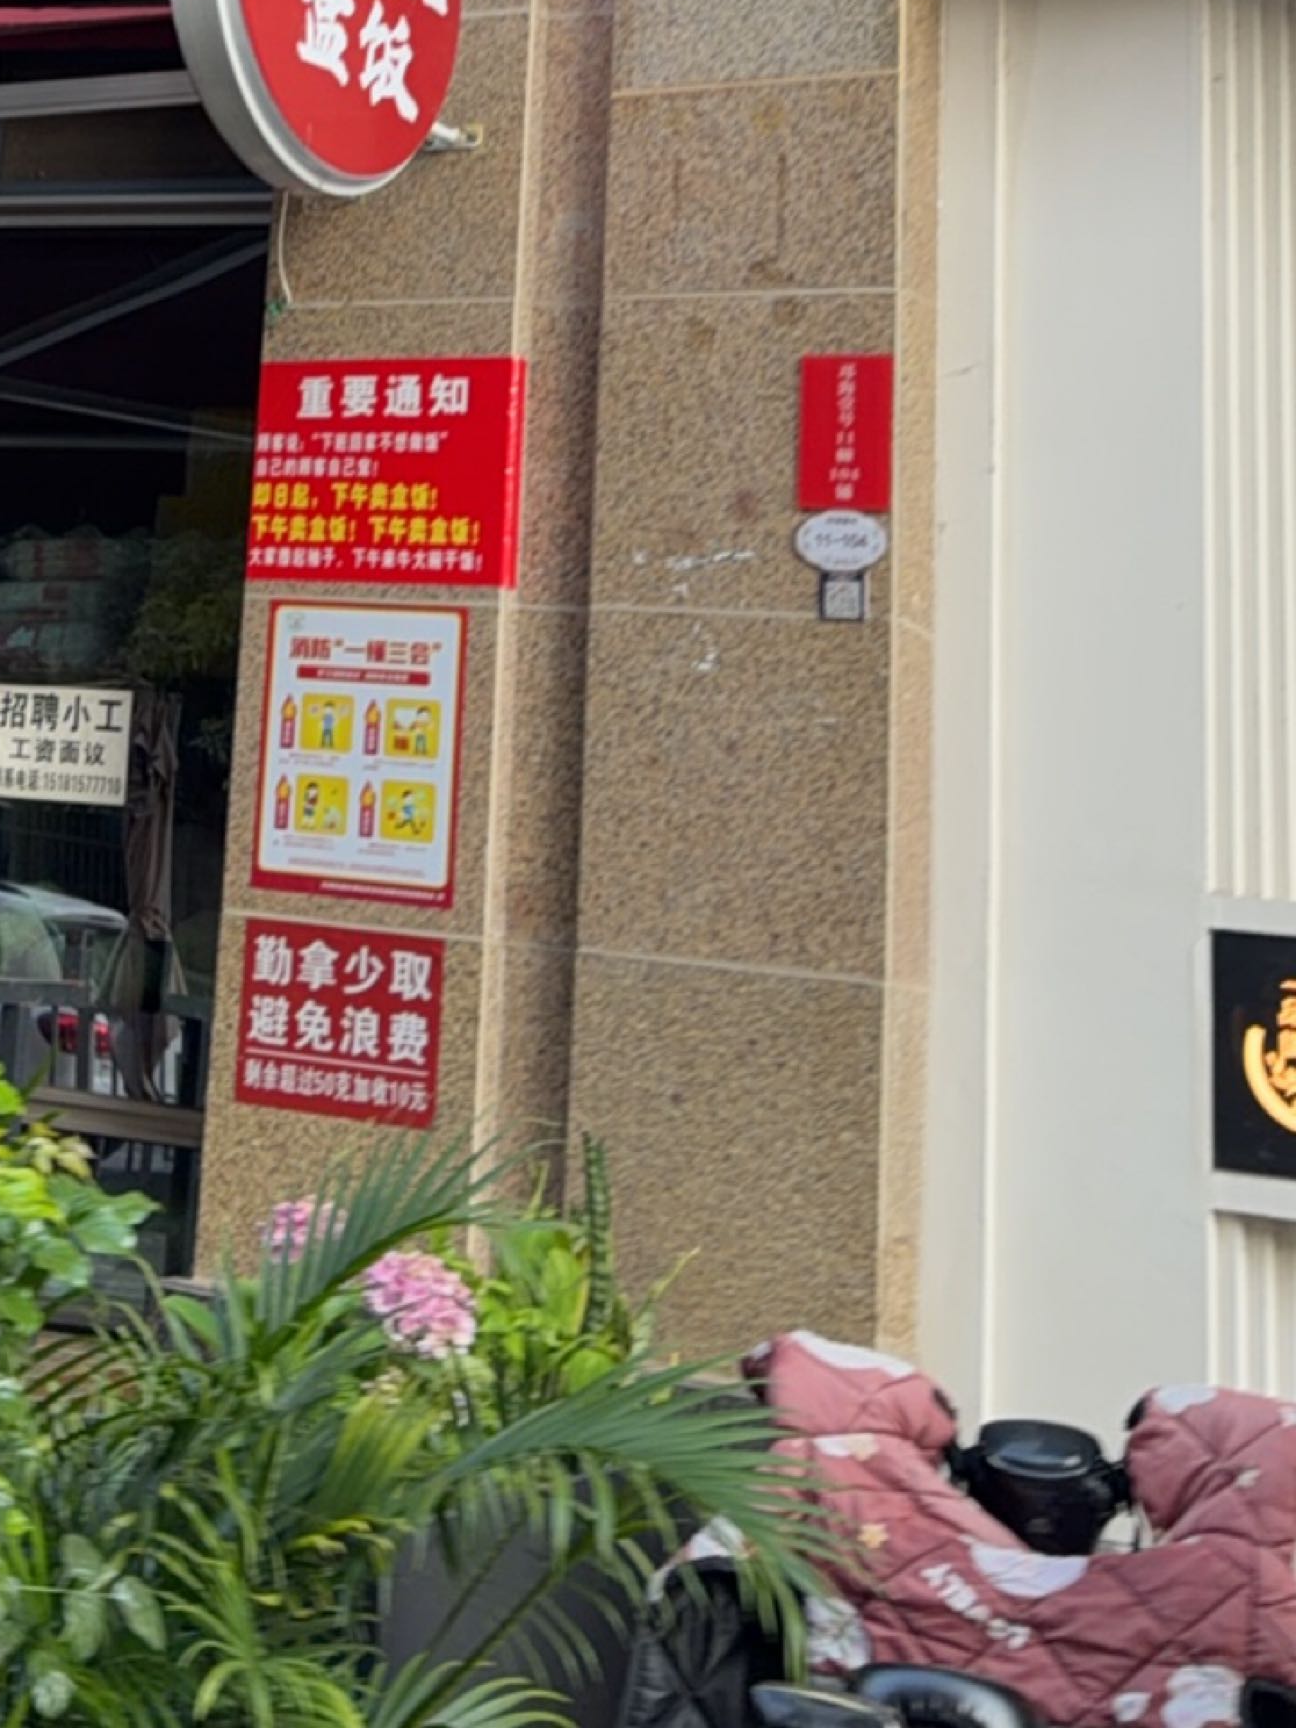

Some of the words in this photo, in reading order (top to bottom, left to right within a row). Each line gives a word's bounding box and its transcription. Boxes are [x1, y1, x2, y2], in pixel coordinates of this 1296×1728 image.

[296, 372, 470, 419] 重要通知
[0, 691, 123, 733] 招聘小工
[9, 737, 104, 765] 工资面议
[253, 934, 432, 1001] 勤拿少取
[247, 995, 429, 1065] 避免浪费
